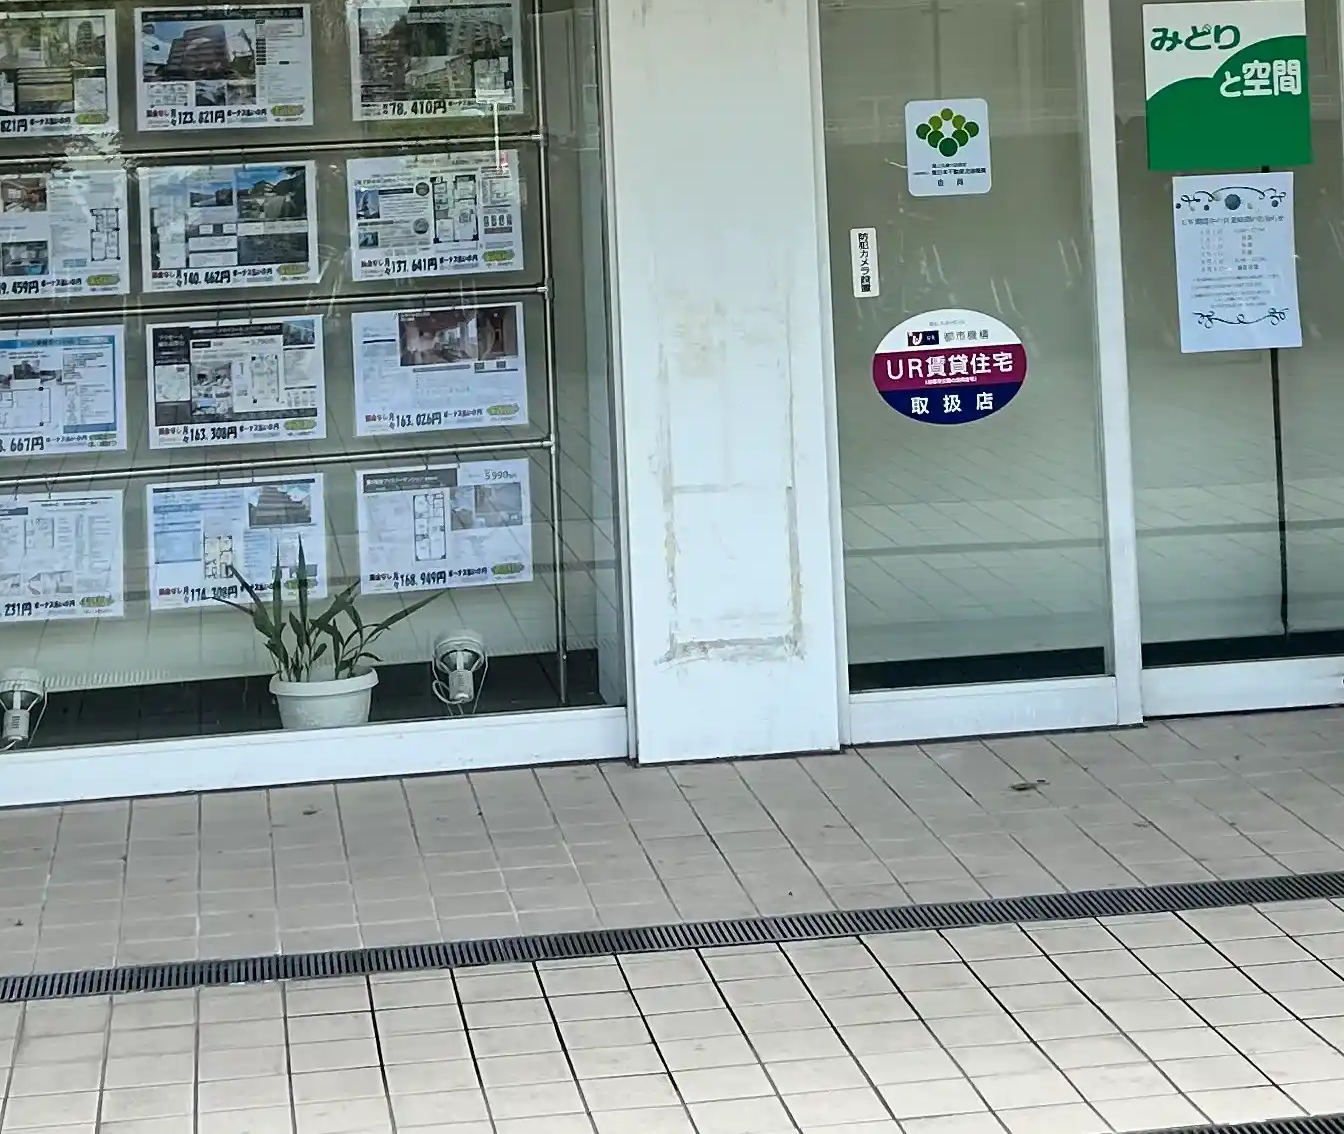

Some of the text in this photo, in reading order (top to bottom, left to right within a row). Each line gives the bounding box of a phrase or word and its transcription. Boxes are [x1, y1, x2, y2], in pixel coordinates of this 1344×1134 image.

[1150, 23, 1240, 52] みどり
[1220, 59, 1302, 98] と空間
[887, 352, 1013, 380] UR賃貸住宅
[911, 392, 994, 415] 取扱店
